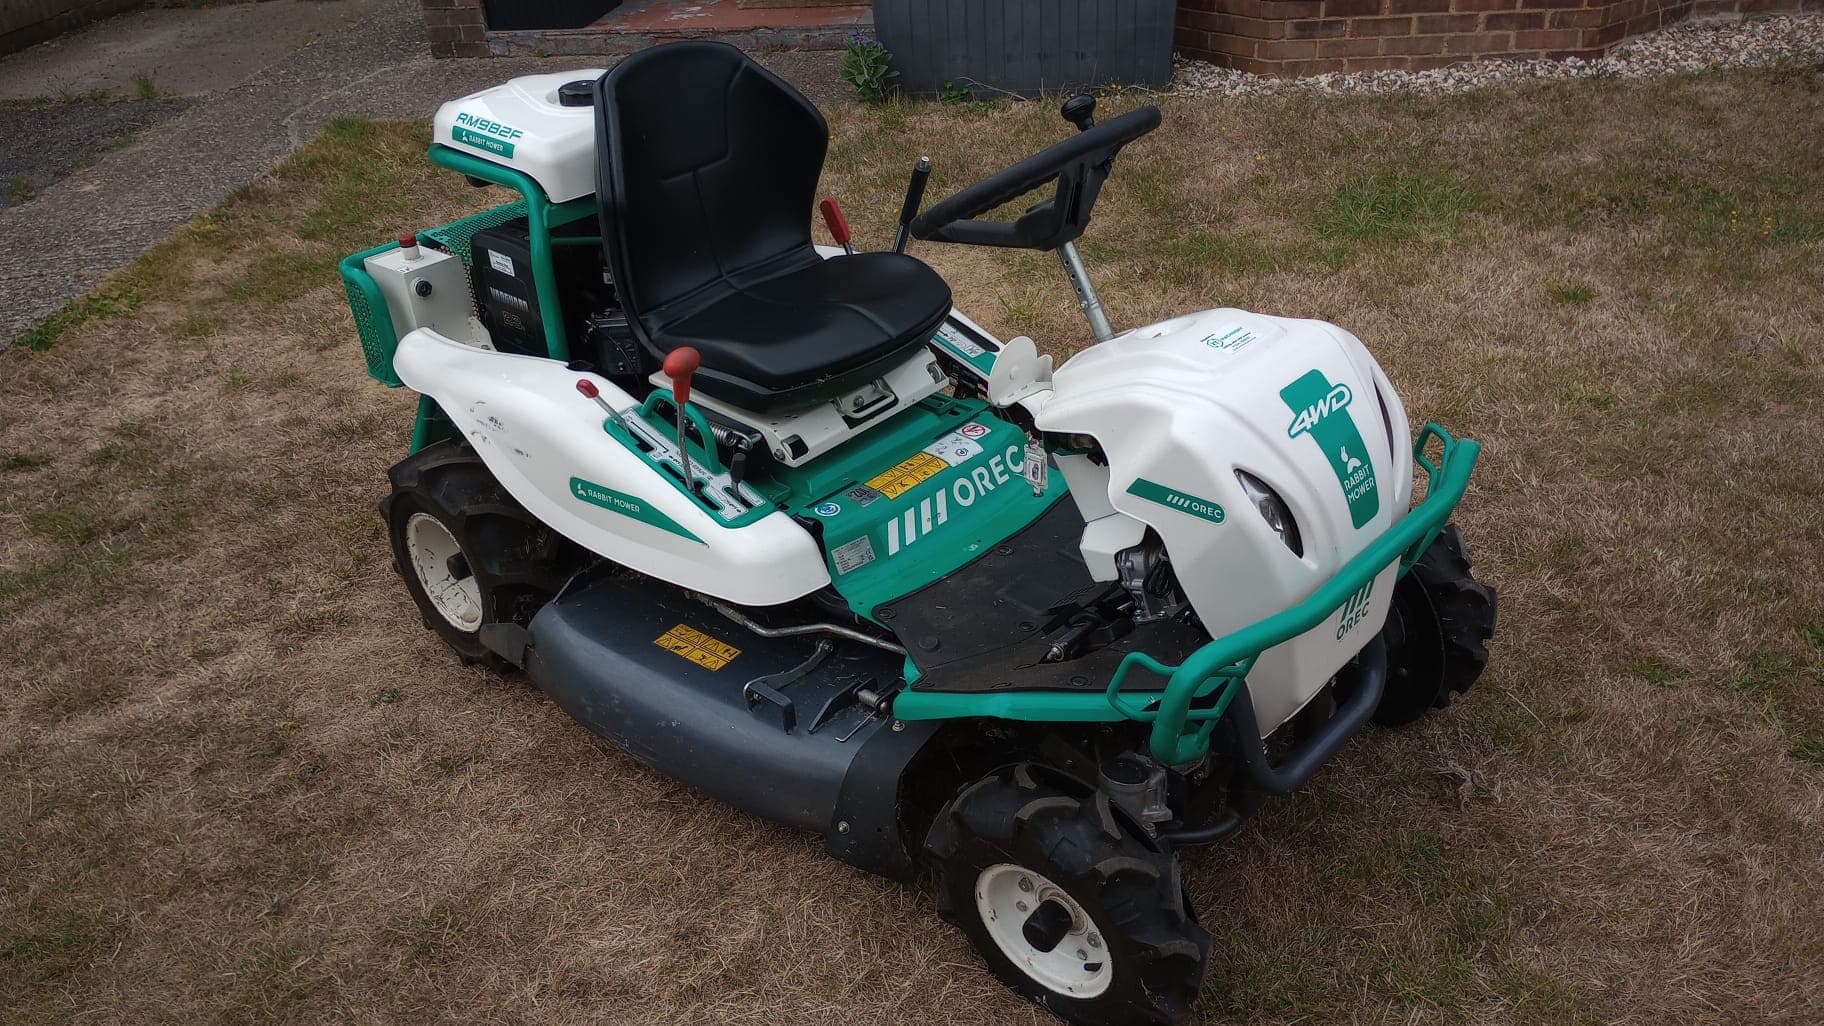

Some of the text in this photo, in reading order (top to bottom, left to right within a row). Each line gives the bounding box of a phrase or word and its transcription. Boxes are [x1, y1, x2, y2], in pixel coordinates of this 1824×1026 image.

[455, 112, 524, 139] RM982F
[469, 134, 504, 152] RABBIT MOWER
[1289, 384, 1352, 437] 4WD
[953, 444, 1024, 507] OREC
[1343, 464, 1370, 490] RABBIT
[588, 489, 640, 513] RABBIT MOWER
[1347, 477, 1375, 504] MOWER
[1191, 502, 1222, 519] OREC
[1336, 602, 1370, 641] OREC
